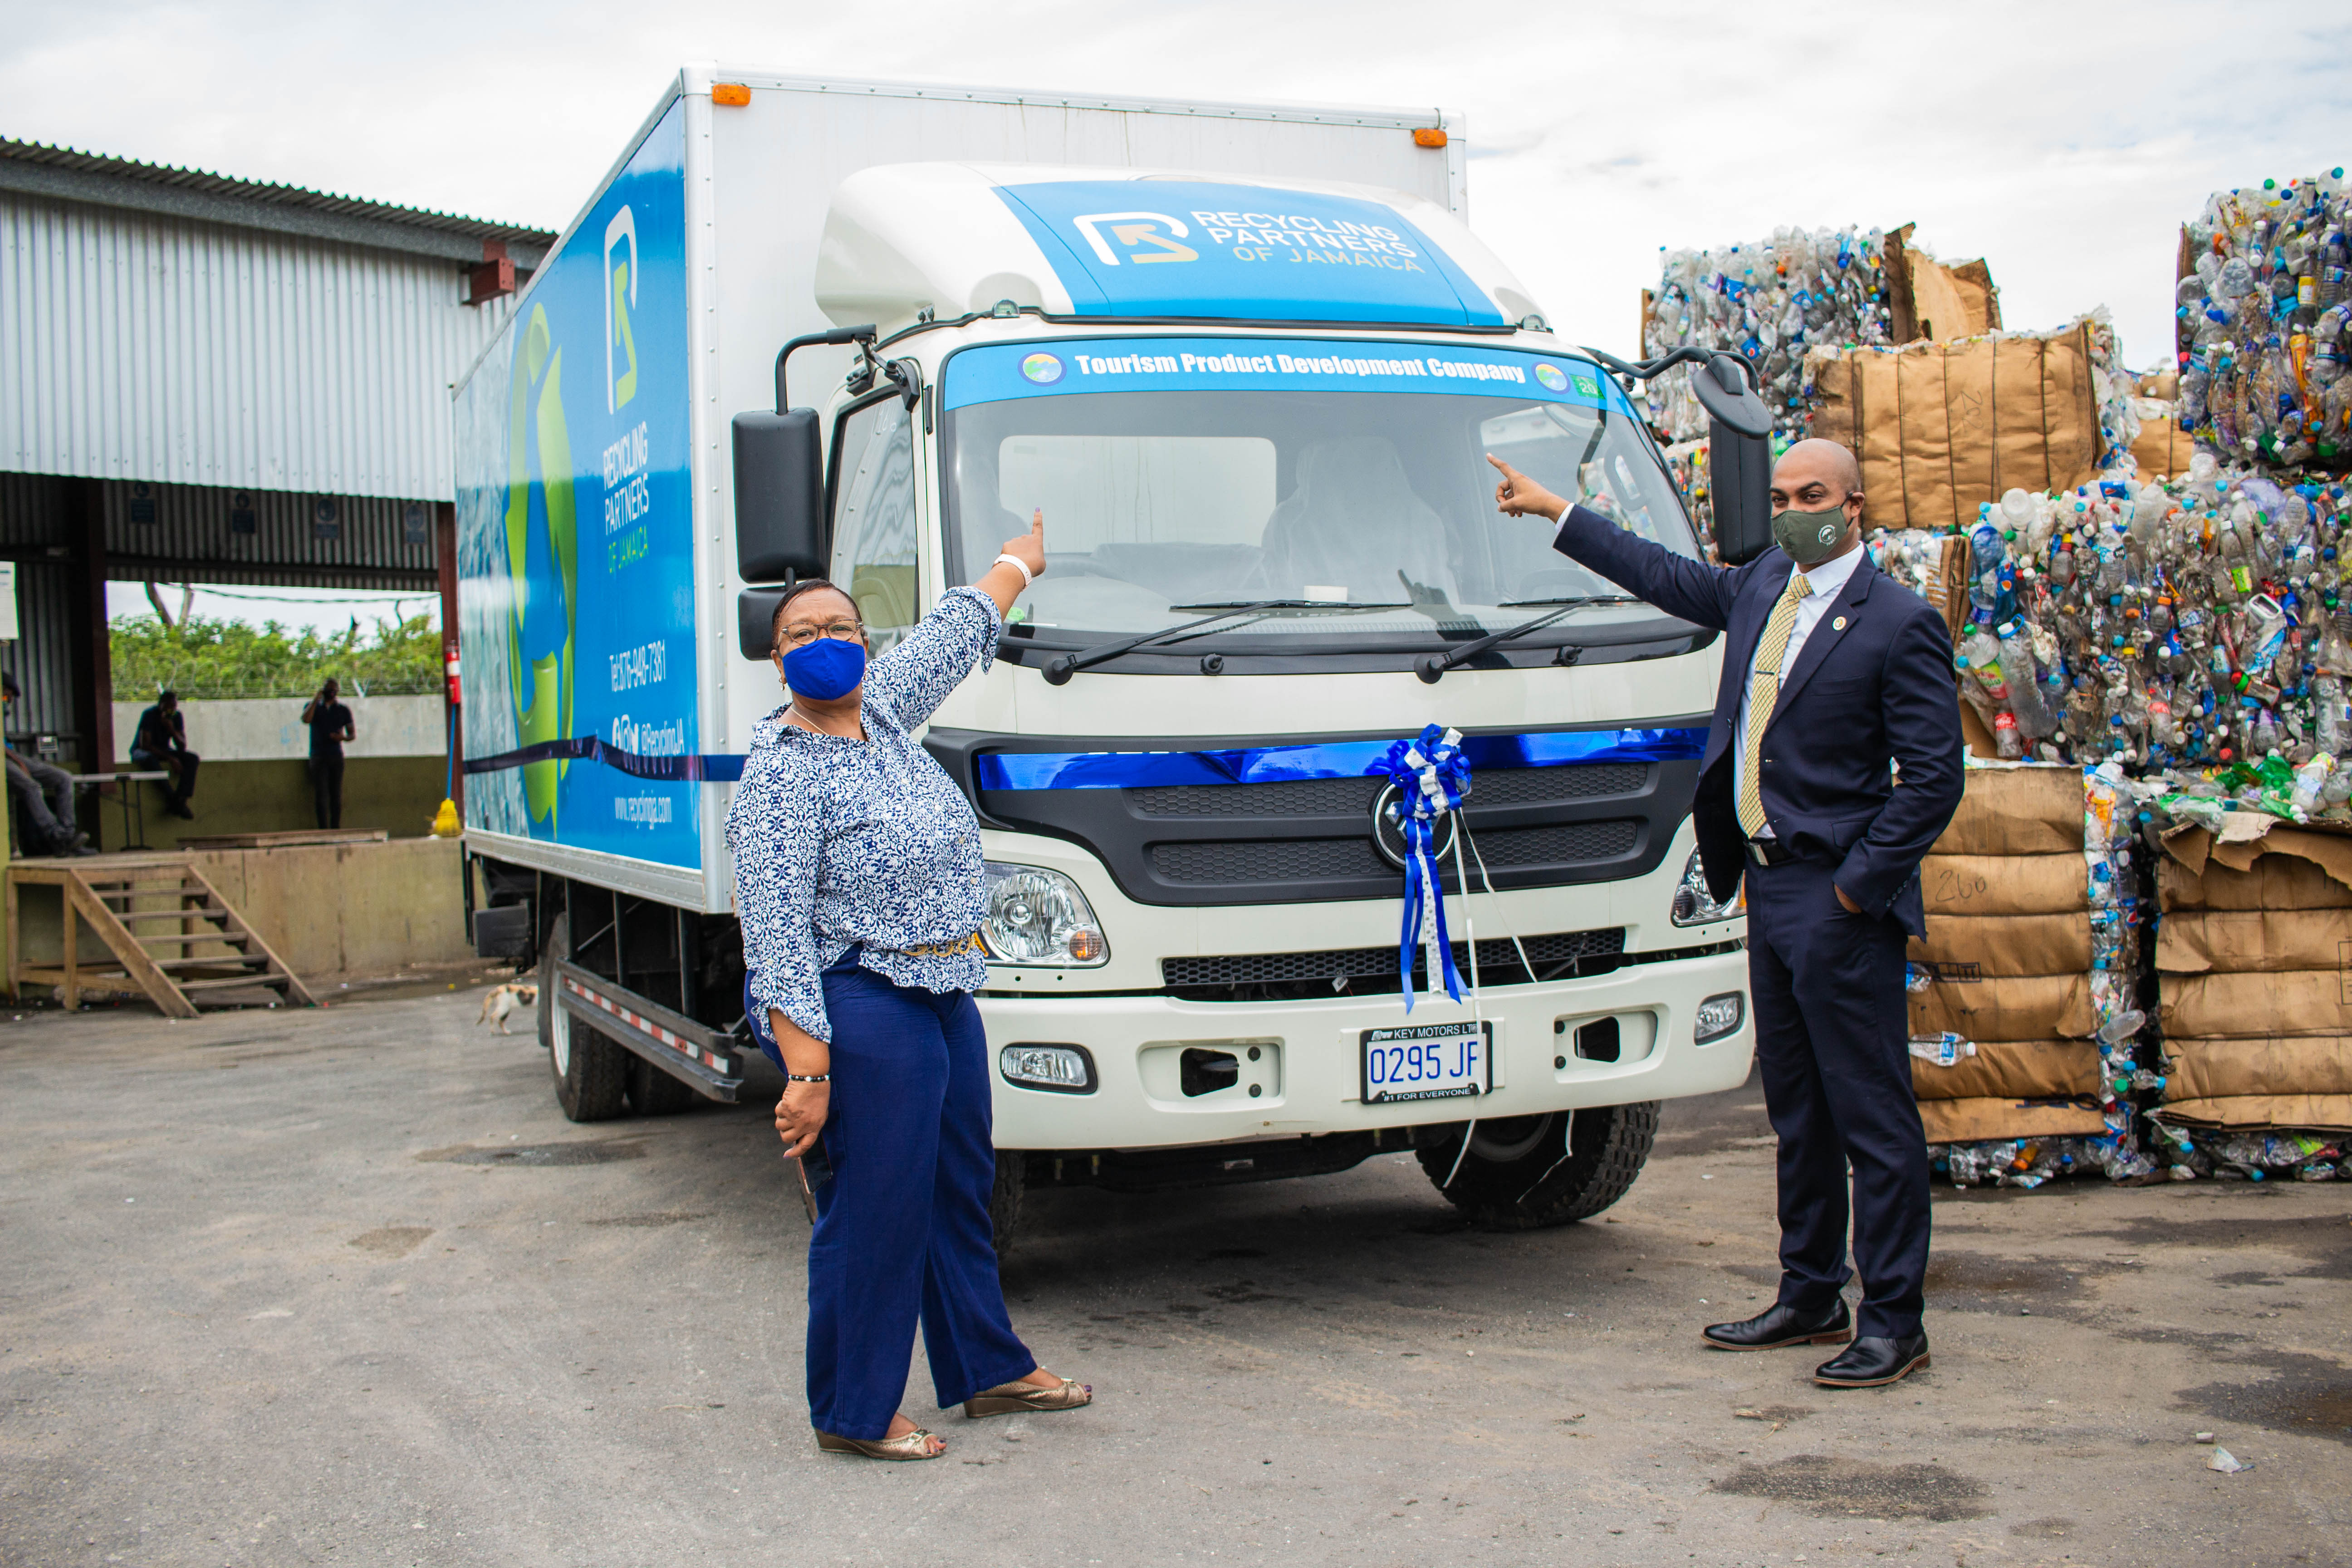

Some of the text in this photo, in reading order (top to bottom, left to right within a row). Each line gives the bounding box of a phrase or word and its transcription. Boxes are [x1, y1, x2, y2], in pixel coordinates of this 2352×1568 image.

[1190, 211, 1400, 242] RECYCLING
[1207, 228, 1417, 258] PARTNERS
[1233, 246, 1426, 274] OF JAMAICA
[1075, 353, 1526, 384] Tourism Product Development Company
[603, 421, 648, 491] RECYCLING
[605, 472, 649, 536] PARTNERS
[608, 524, 649, 573] OF JAMAICA
[1394, 1028, 1415, 1039] KEY
[1417, 1024, 1460, 1038] MOTORS
[1370, 1044, 1441, 1084] 0295
[1383, 1088, 1471, 1102] #1 FOR EVERYONE
